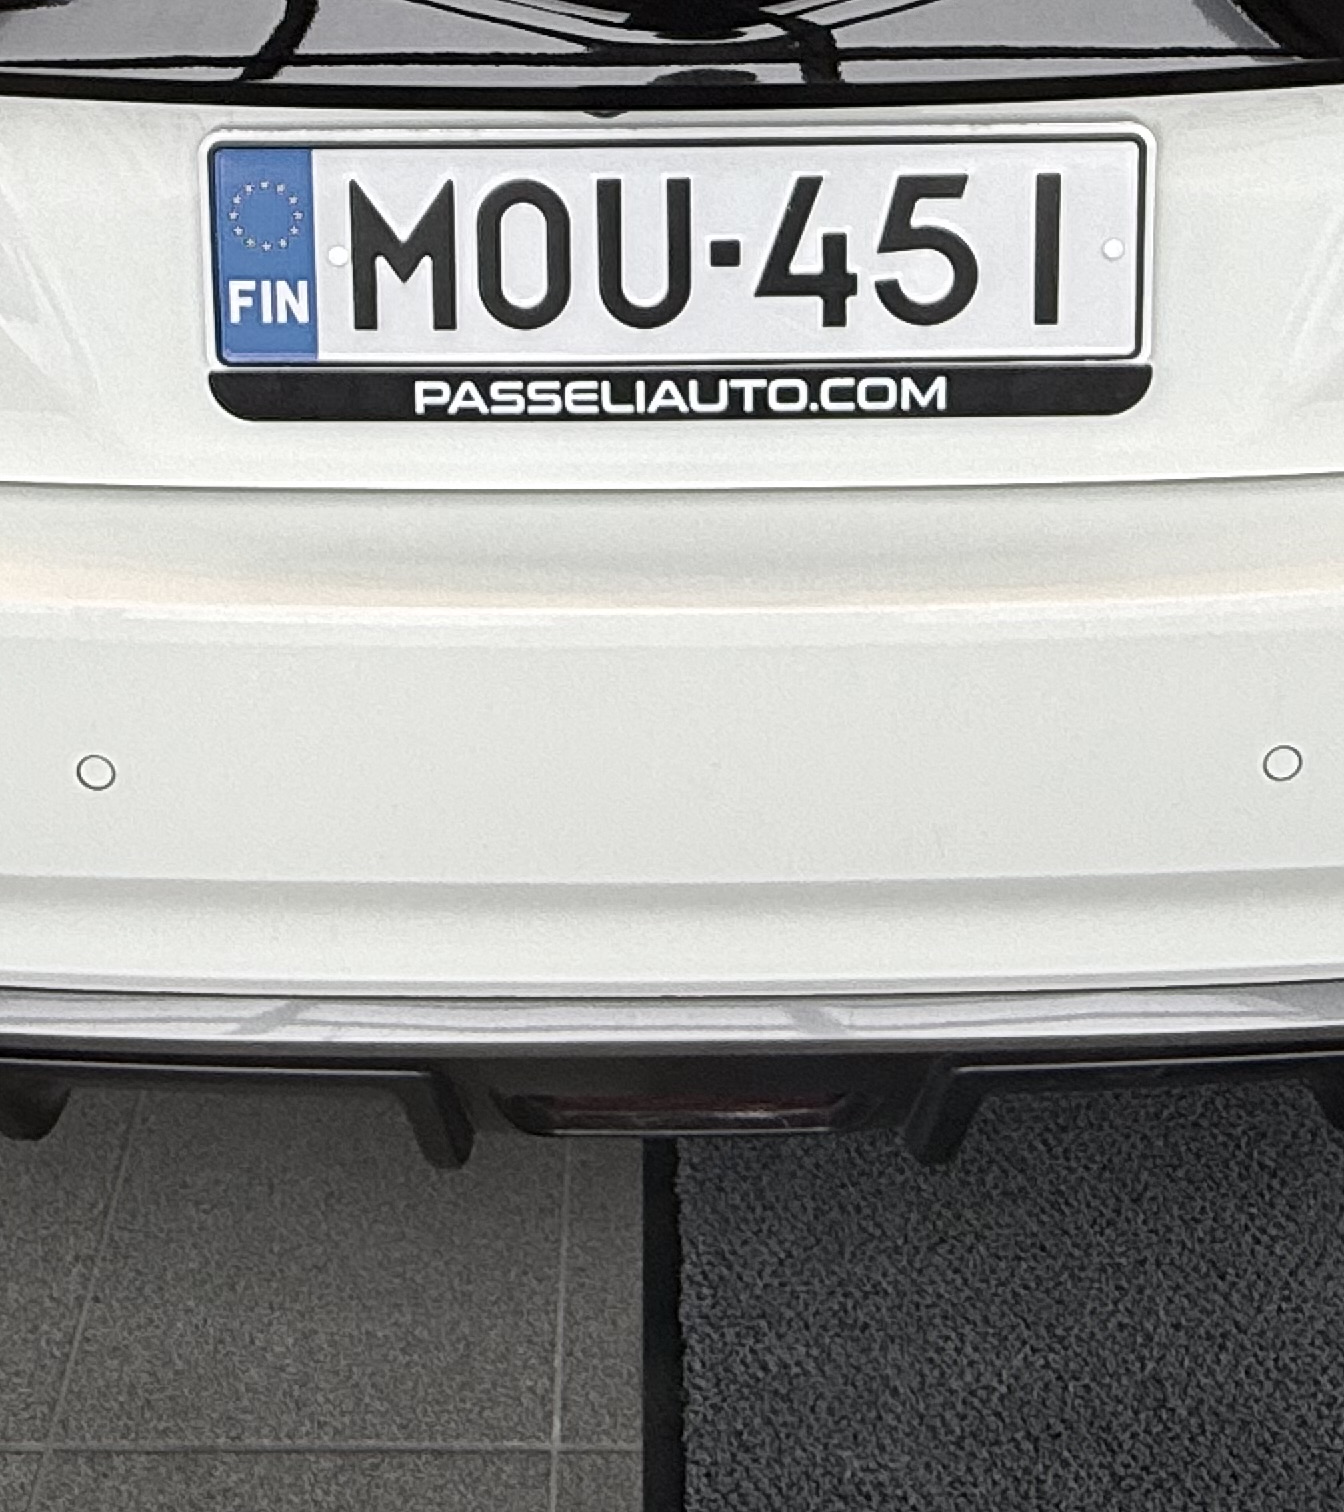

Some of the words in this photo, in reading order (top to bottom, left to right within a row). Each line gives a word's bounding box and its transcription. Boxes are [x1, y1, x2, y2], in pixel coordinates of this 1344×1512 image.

[349, 172, 1062, 331] MOU-451
[228, 278, 310, 324] FIN
[413, 375, 948, 416] PASSELIAUTO.COM
